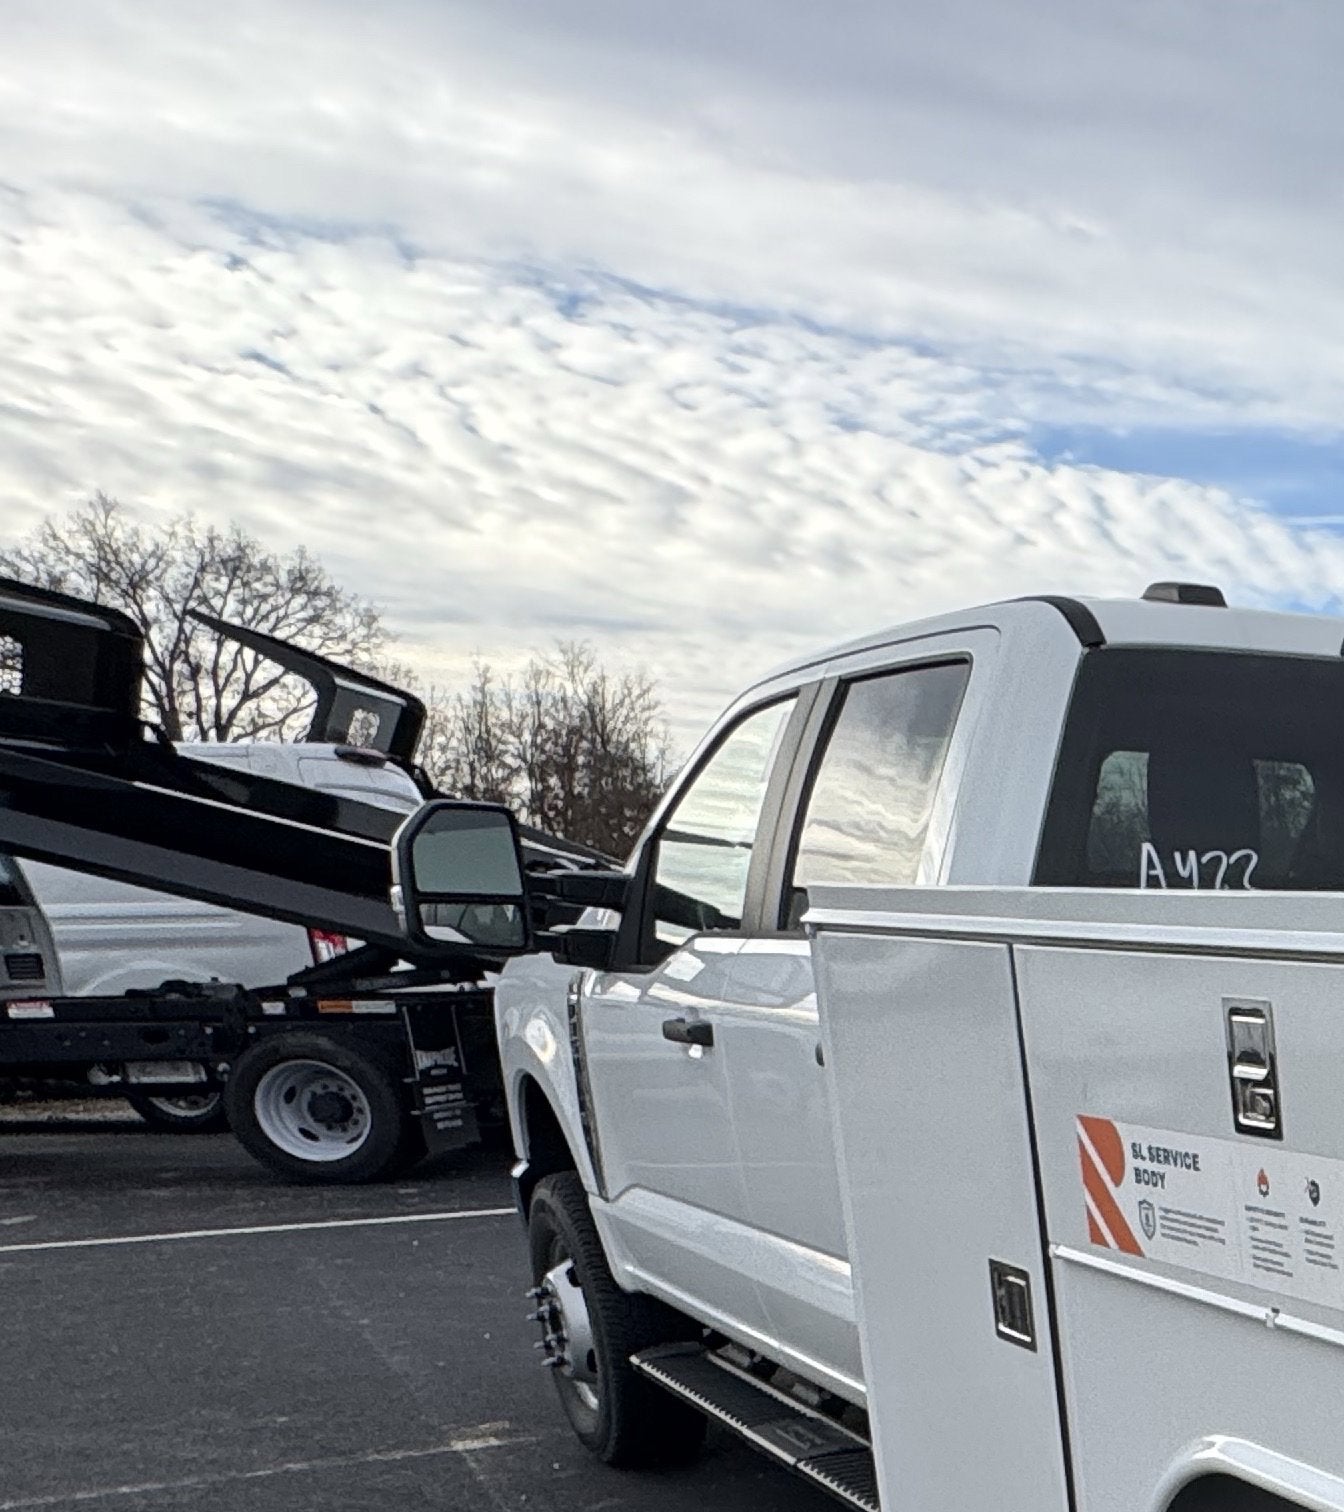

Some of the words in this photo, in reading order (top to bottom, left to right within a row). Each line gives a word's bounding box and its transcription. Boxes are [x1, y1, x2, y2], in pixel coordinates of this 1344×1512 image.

[1131, 1142, 1146, 1161] SL
[1147, 1145, 1201, 1172] SERVICE
[1134, 1167, 1166, 1190] BODY
